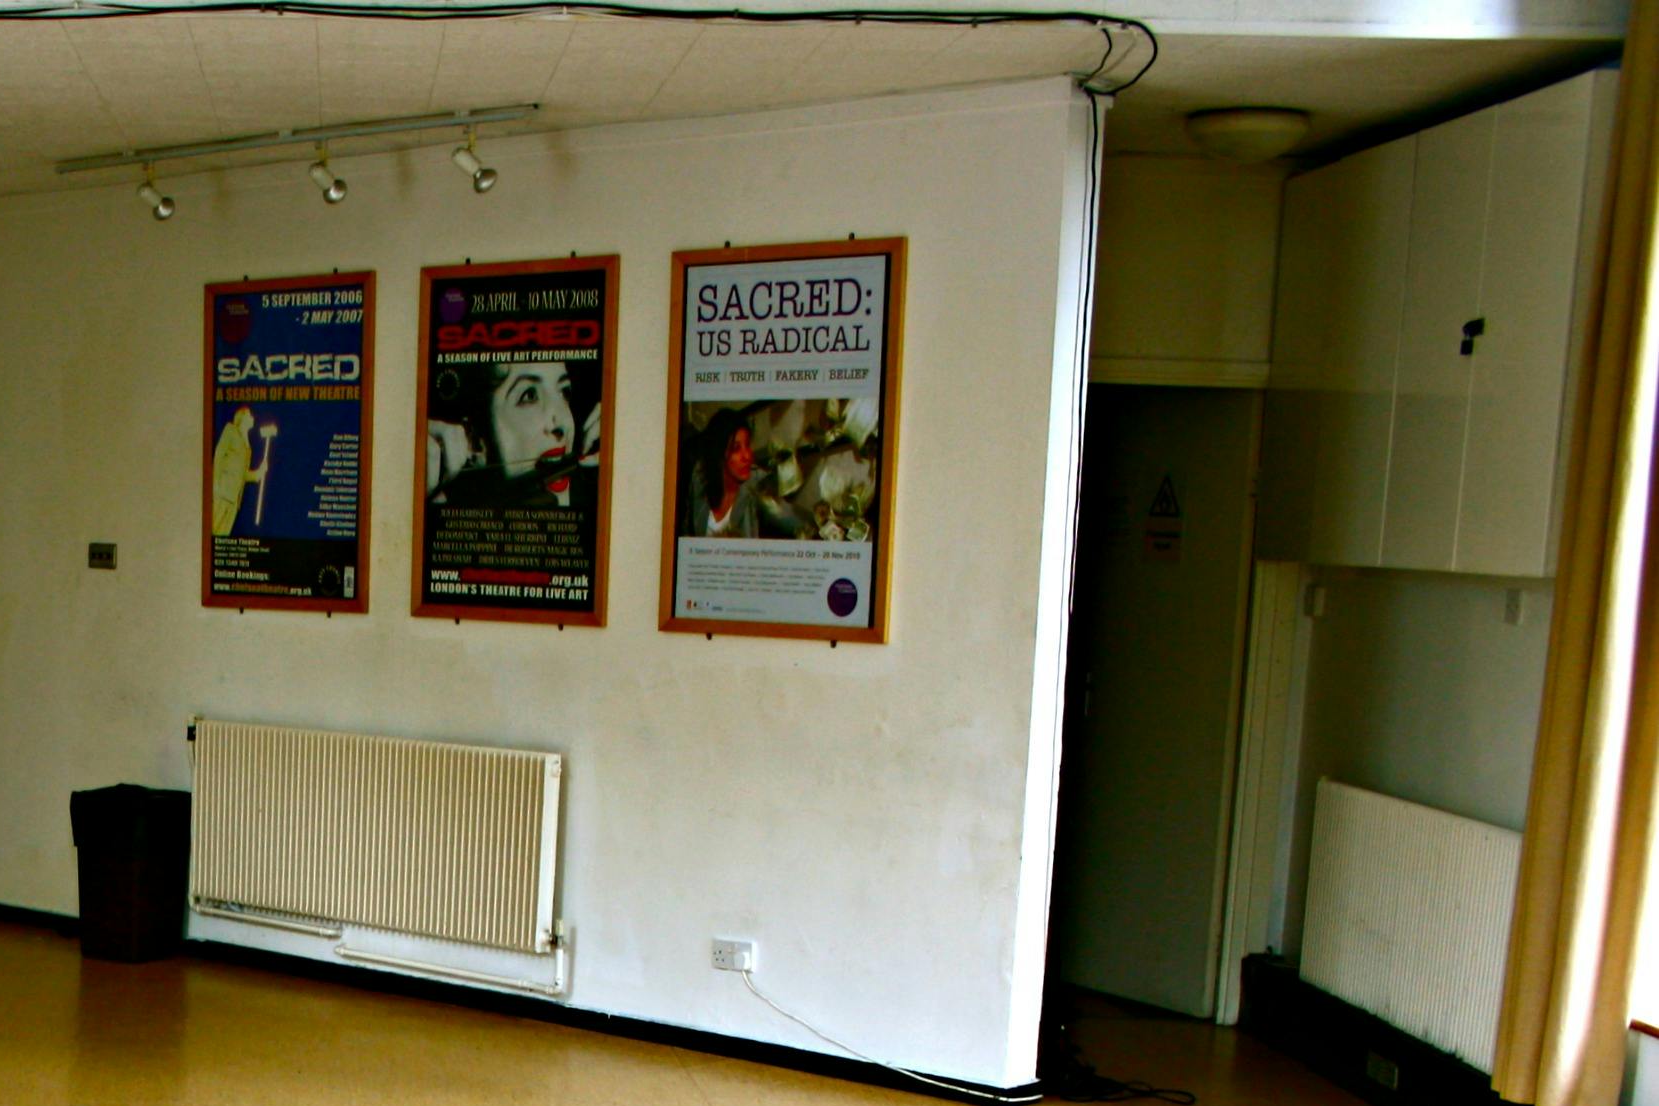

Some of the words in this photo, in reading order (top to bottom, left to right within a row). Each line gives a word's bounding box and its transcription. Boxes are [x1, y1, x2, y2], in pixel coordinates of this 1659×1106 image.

[262, 294, 269, 308] 5
[271, 291, 332, 308] SEPTEMBER
[334, 289, 363, 305] 2006
[471, 295, 485, 313] 28
[486, 292, 519, 312] APRIL
[529, 291, 539, 311] 10
[541, 289, 568, 310] MAY
[570, 288, 599, 308] 2008
[697, 277, 872, 323] SACRED:
[301, 312, 309, 325] 2
[311, 310, 333, 325] MAY
[335, 309, 364, 324] 2007
[437, 319, 600, 350] SACRED
[697, 330, 731, 357] US
[739, 325, 871, 355] RADICAL
[437, 354, 443, 363] A
[445, 352, 478, 363] SEASON
[480, 352, 491, 362] OF
[493, 351, 511, 362] LIVE
[514, 351, 529, 361] ART
[531, 349, 598, 361] PERFORMANCE
[217, 354, 360, 383] SACRED
[695, 372, 720, 383] RISK
[729, 371, 765, 382] TRUTH
[775, 369, 818, 381] FAKERY
[829, 368, 869, 380] BELIEF
[216, 388, 223, 401] A
[226, 387, 267, 401] SEASON
[270, 387, 283, 400] OF
[286, 386, 311, 400] NEW
[313, 385, 360, 400] THEATRE
[430, 582, 478, 595] LONDON'S
[480, 584, 521, 597] THEATRE
[524, 586, 543, 598] FOR
[545, 588, 566, 599] LIVE
[568, 589, 588, 601] ART
